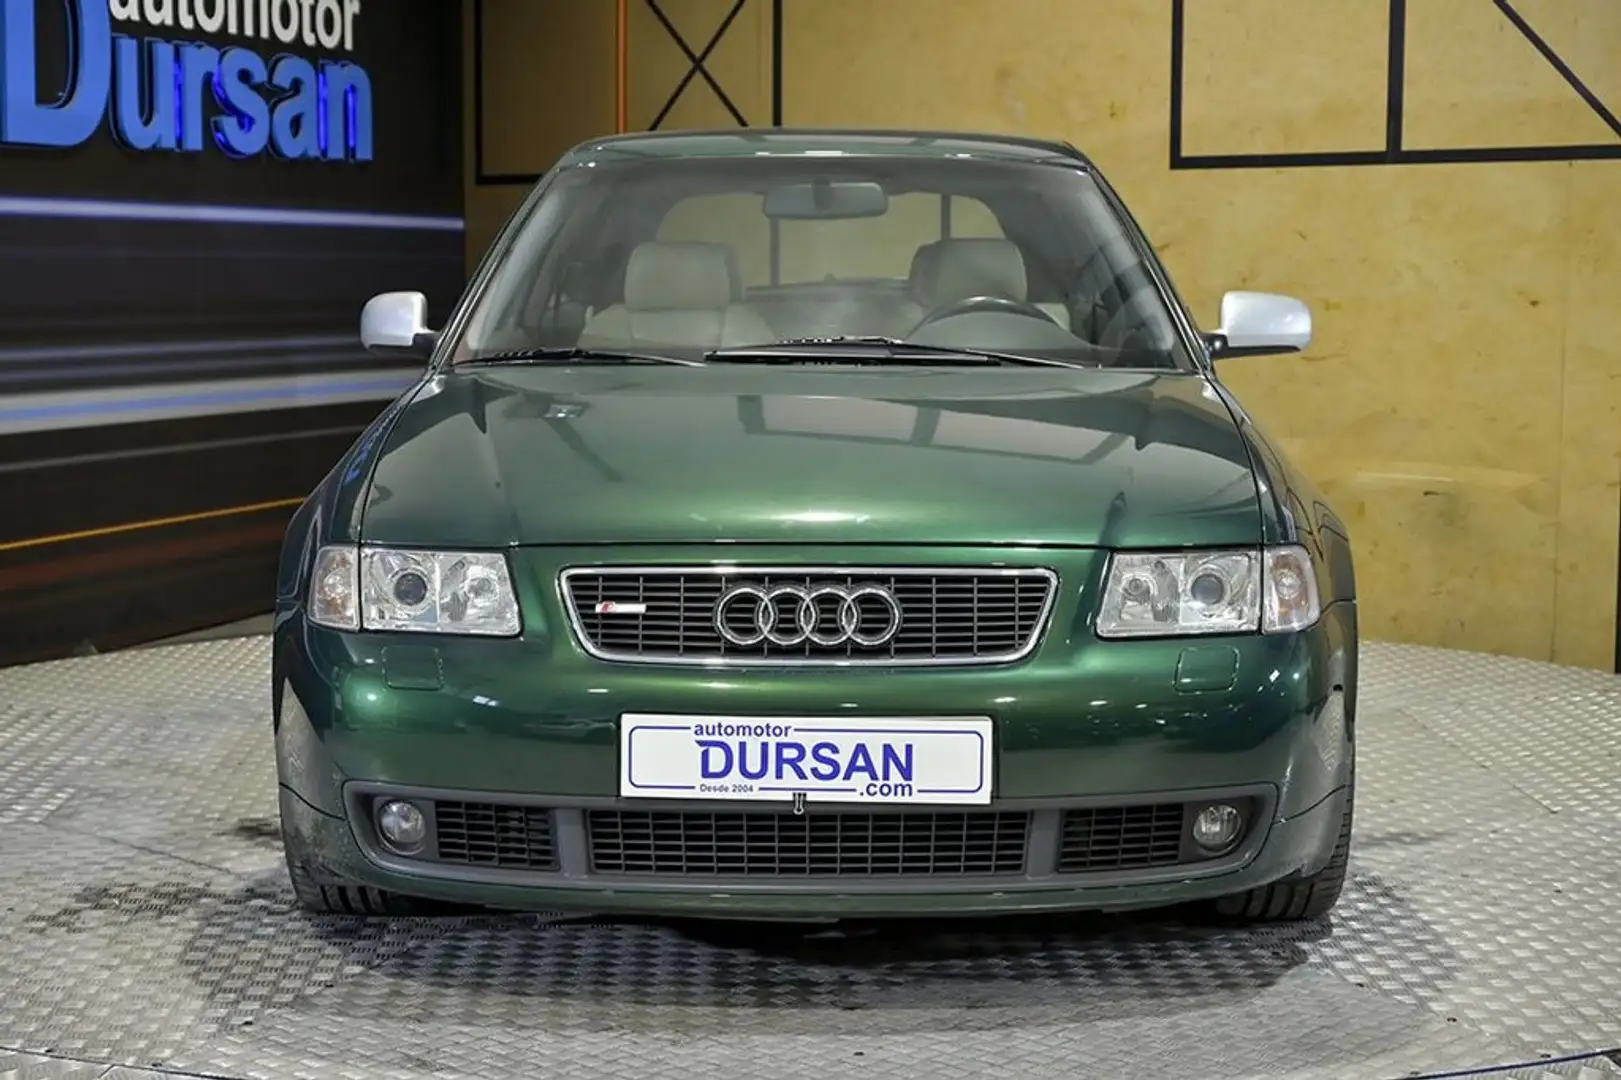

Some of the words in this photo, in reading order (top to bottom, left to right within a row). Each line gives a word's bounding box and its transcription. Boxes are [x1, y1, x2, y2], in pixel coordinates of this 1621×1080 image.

[0, 0, 374, 162] Dursan
[694, 722, 792, 738] automotor
[695, 739, 913, 782] DURSAN
[700, 783, 729, 793] Desde
[732, 784, 754, 793] 2004
[859, 780, 913, 798] .com
